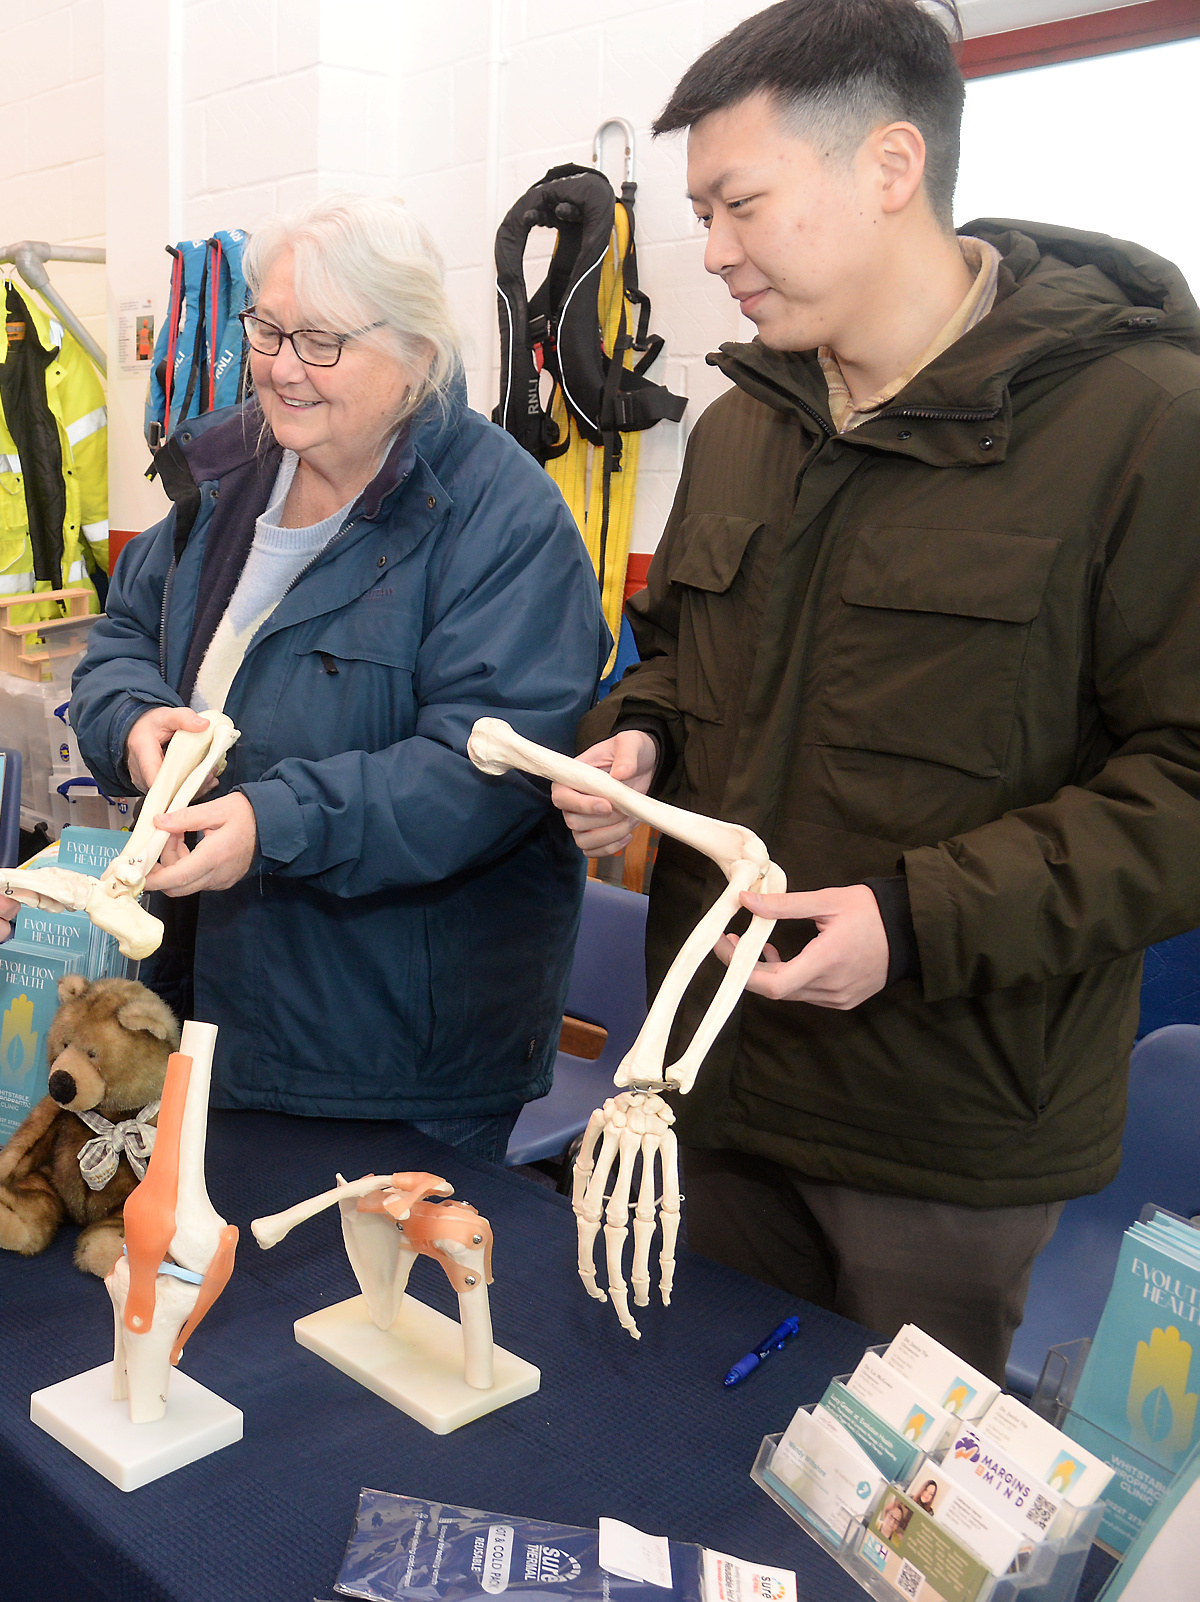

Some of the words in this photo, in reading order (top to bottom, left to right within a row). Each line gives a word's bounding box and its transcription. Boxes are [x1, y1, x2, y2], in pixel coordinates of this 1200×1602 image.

[215, 349, 234, 380] RNLI
[527, 379, 539, 415] RNLI
[67, 841, 122, 856] EVOLUTION
[24, 918, 80, 938] EVOLUTION
[32, 930, 70, 948] HEALTH
[6, 971, 44, 990] HEALTH
[0, 1102, 19, 1111] CLINIC
[981, 1455, 1031, 1497] MARGINS
[982, 1471, 1024, 1507] MIND
[1120, 1480, 1154, 1507] CLINIC
[471, 1536, 485, 1572] REUSABLE
[491, 1545, 505, 1570] COLD
[525, 1543, 539, 1581] THERMAL
[540, 1546, 561, 1583] sure
[761, 1575, 772, 1599] sure
